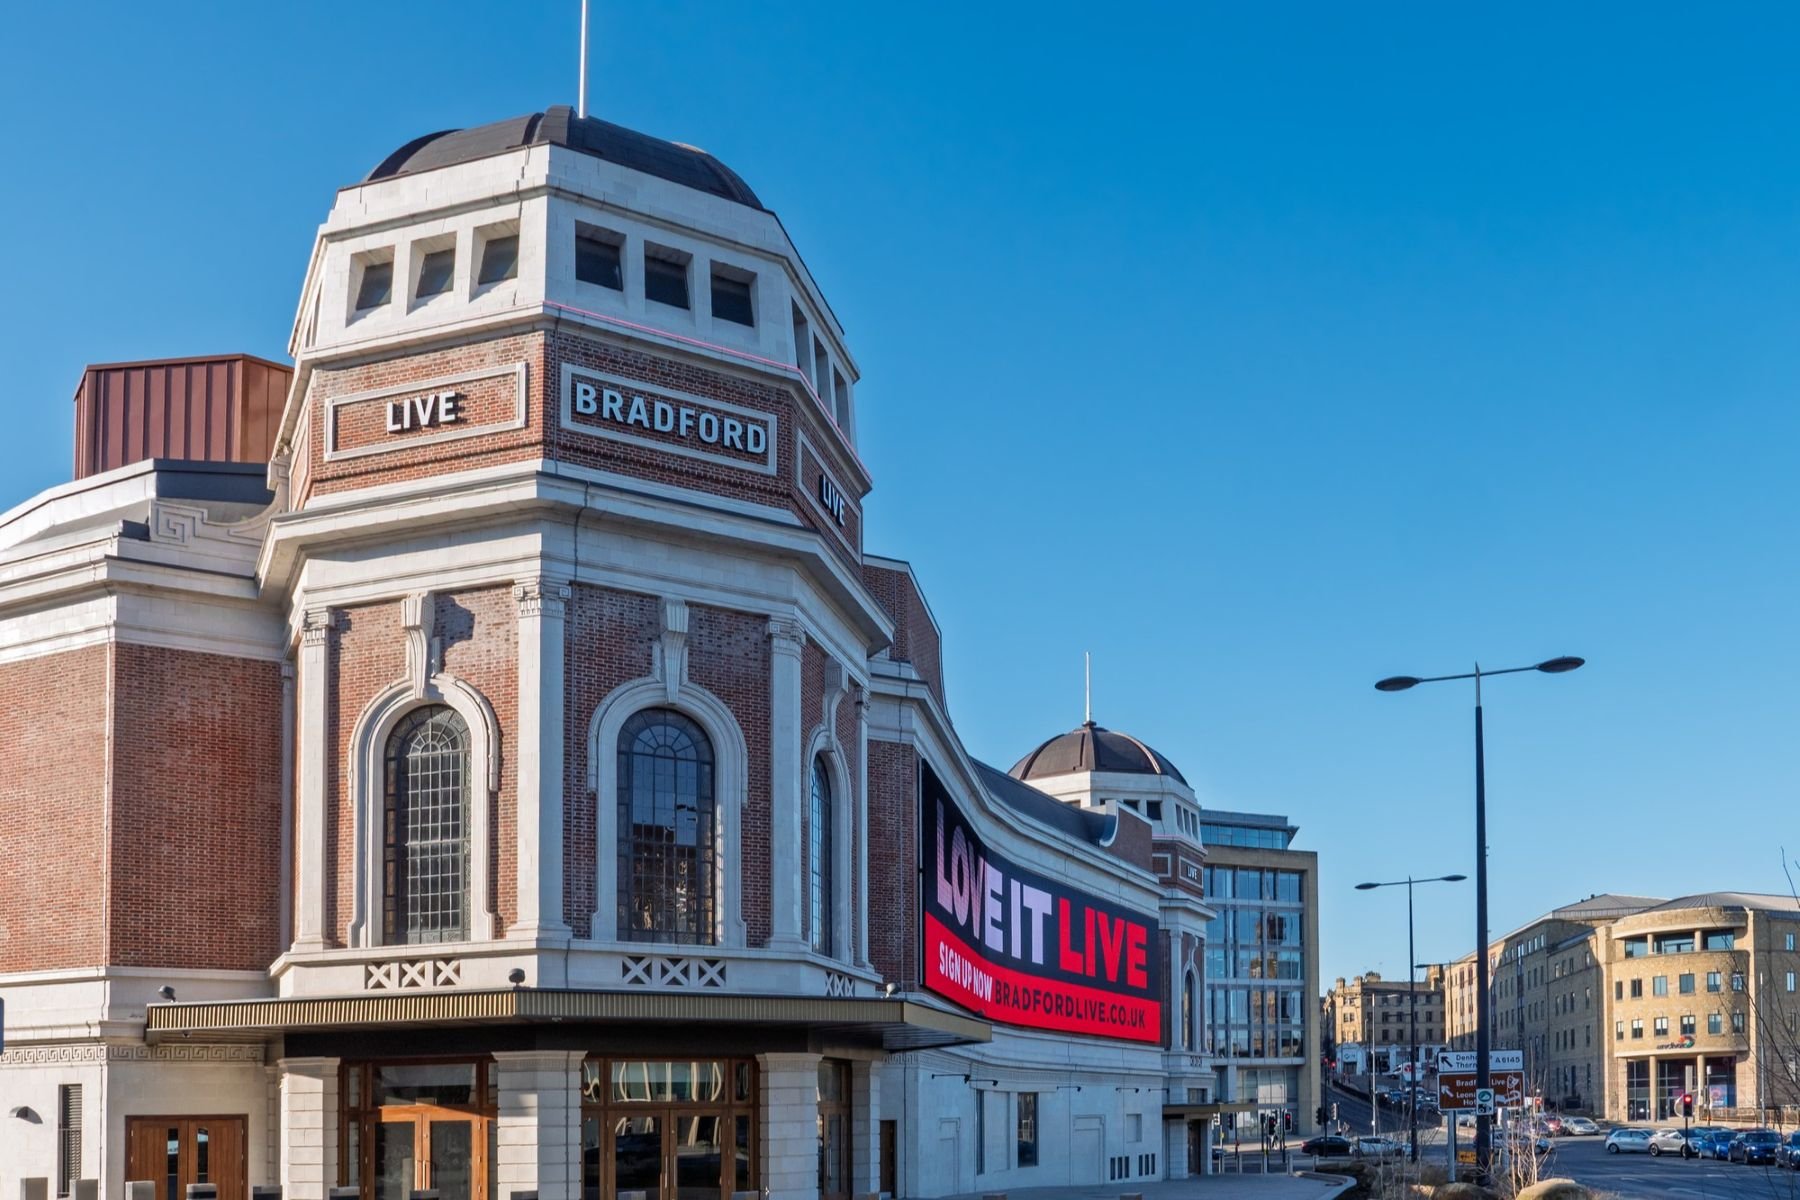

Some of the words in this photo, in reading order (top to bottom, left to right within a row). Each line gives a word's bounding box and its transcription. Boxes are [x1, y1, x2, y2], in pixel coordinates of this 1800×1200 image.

[386, 391, 456, 432] LIVE
[576, 383, 766, 454] BRADFORD
[822, 474, 846, 527] LIVE
[936, 798, 1004, 953] LOVE
[1010, 878, 1052, 965] IT
[1059, 897, 1148, 989] LIVE
[939, 941, 961, 984] SIGN
[961, 957, 973, 991] UP
[973, 966, 993, 1002] NOW
[994, 980, 1146, 1029] BRADFORDLIVE.CO.UK
[1491, 1078, 1506, 1086] Live
